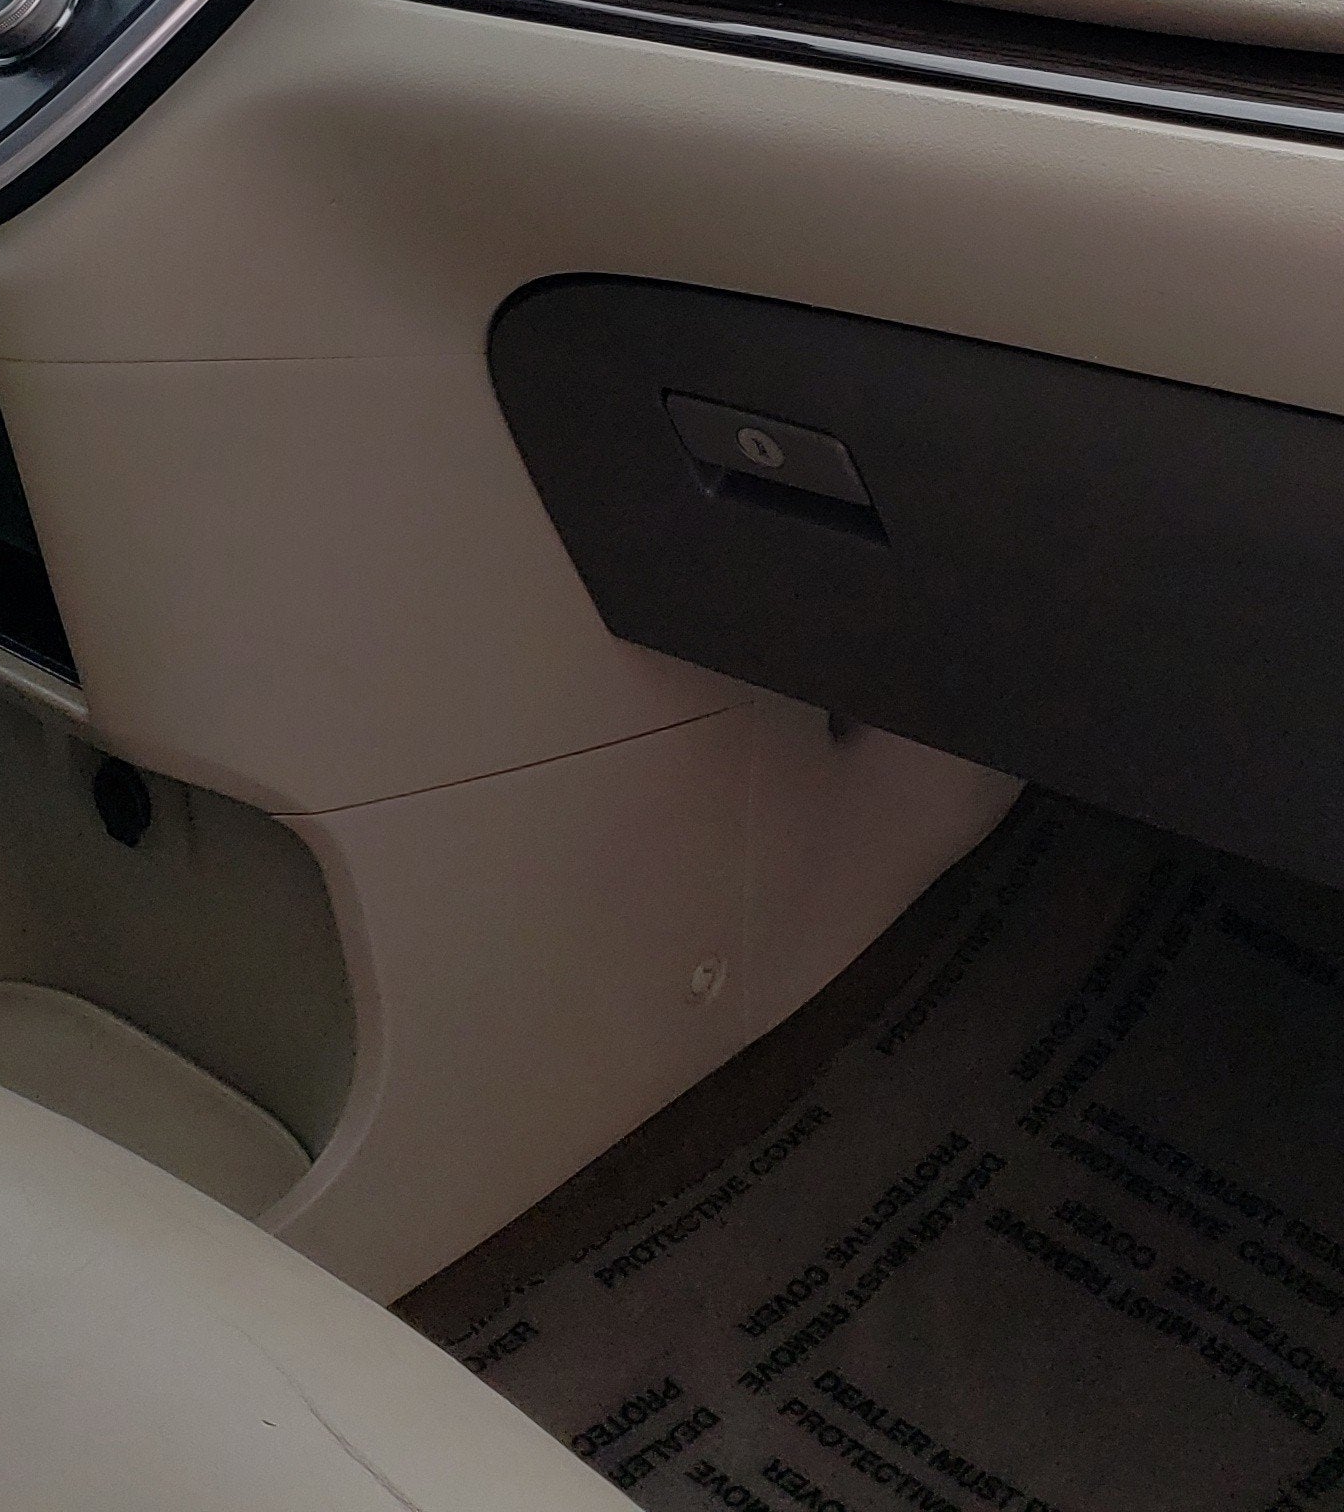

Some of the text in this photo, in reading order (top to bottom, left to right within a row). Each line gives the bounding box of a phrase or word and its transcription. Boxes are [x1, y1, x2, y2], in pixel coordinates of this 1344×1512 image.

[594, 1104, 832, 1288] PROTECTIVE COVER
[1082, 1101, 1194, 1179] DEALER
[737, 1131, 971, 1337] PROTECTIVE COVER
[737, 1151, 1007, 1394] DEALER MUST REMOVE
[1056, 1199, 1155, 1269] COVER
[462, 1320, 540, 1374] OVER
[984, 1207, 1327, 1434] DEALER MUST REMOVE
[571, 1377, 684, 1460] PROTEC
[814, 1369, 1026, 1510] DEALER MUST
[762, 1458, 845, 1512] OVER
